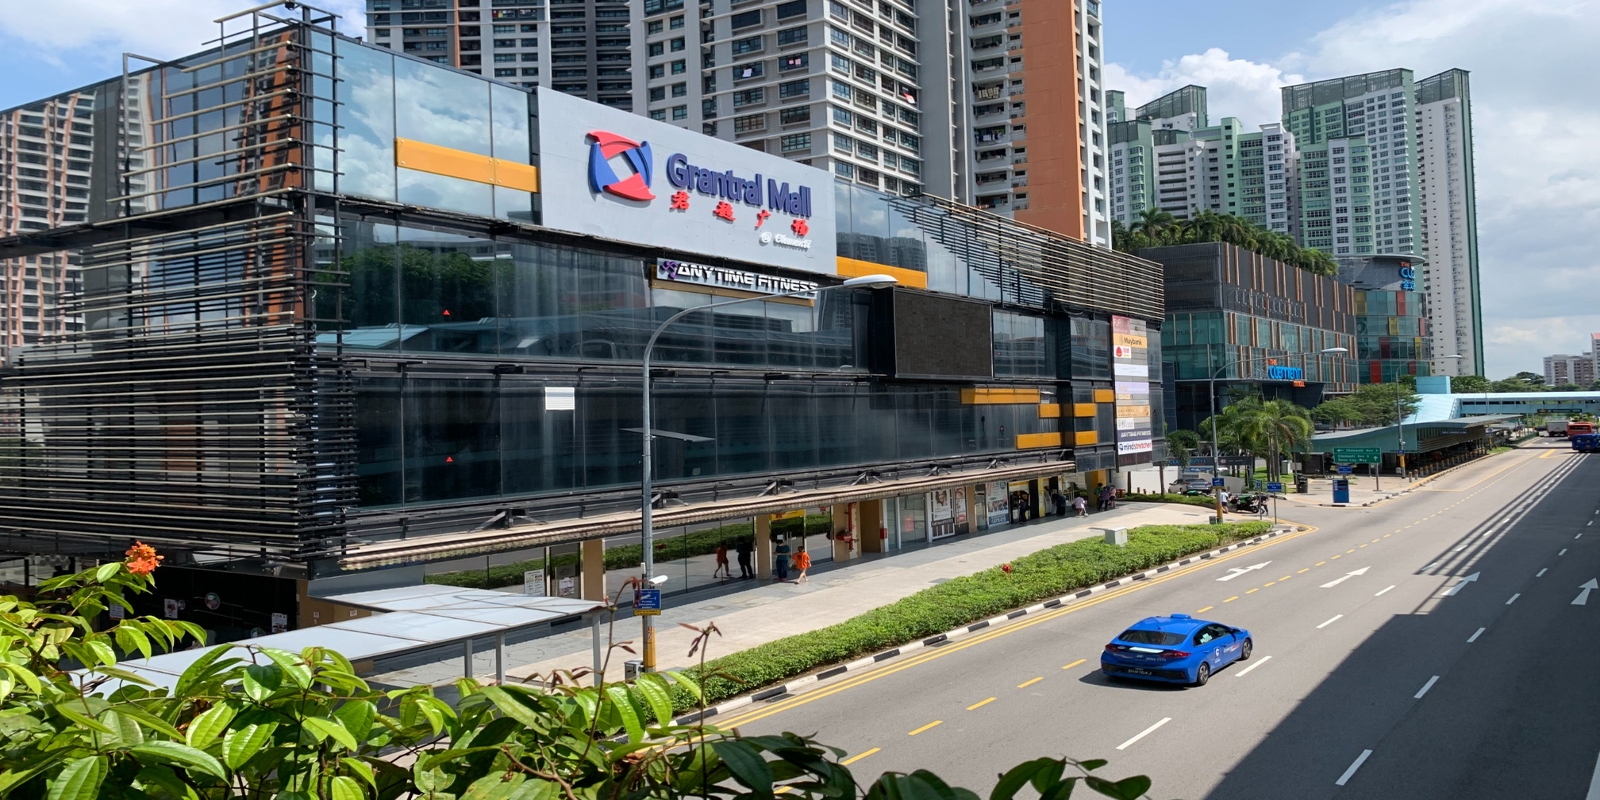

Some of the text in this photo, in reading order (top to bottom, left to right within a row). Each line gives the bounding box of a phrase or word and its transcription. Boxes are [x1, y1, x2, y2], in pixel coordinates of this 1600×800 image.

[667, 153, 812, 217] Grantral Mall
[677, 263, 819, 294] ANYTIME FITNESS
